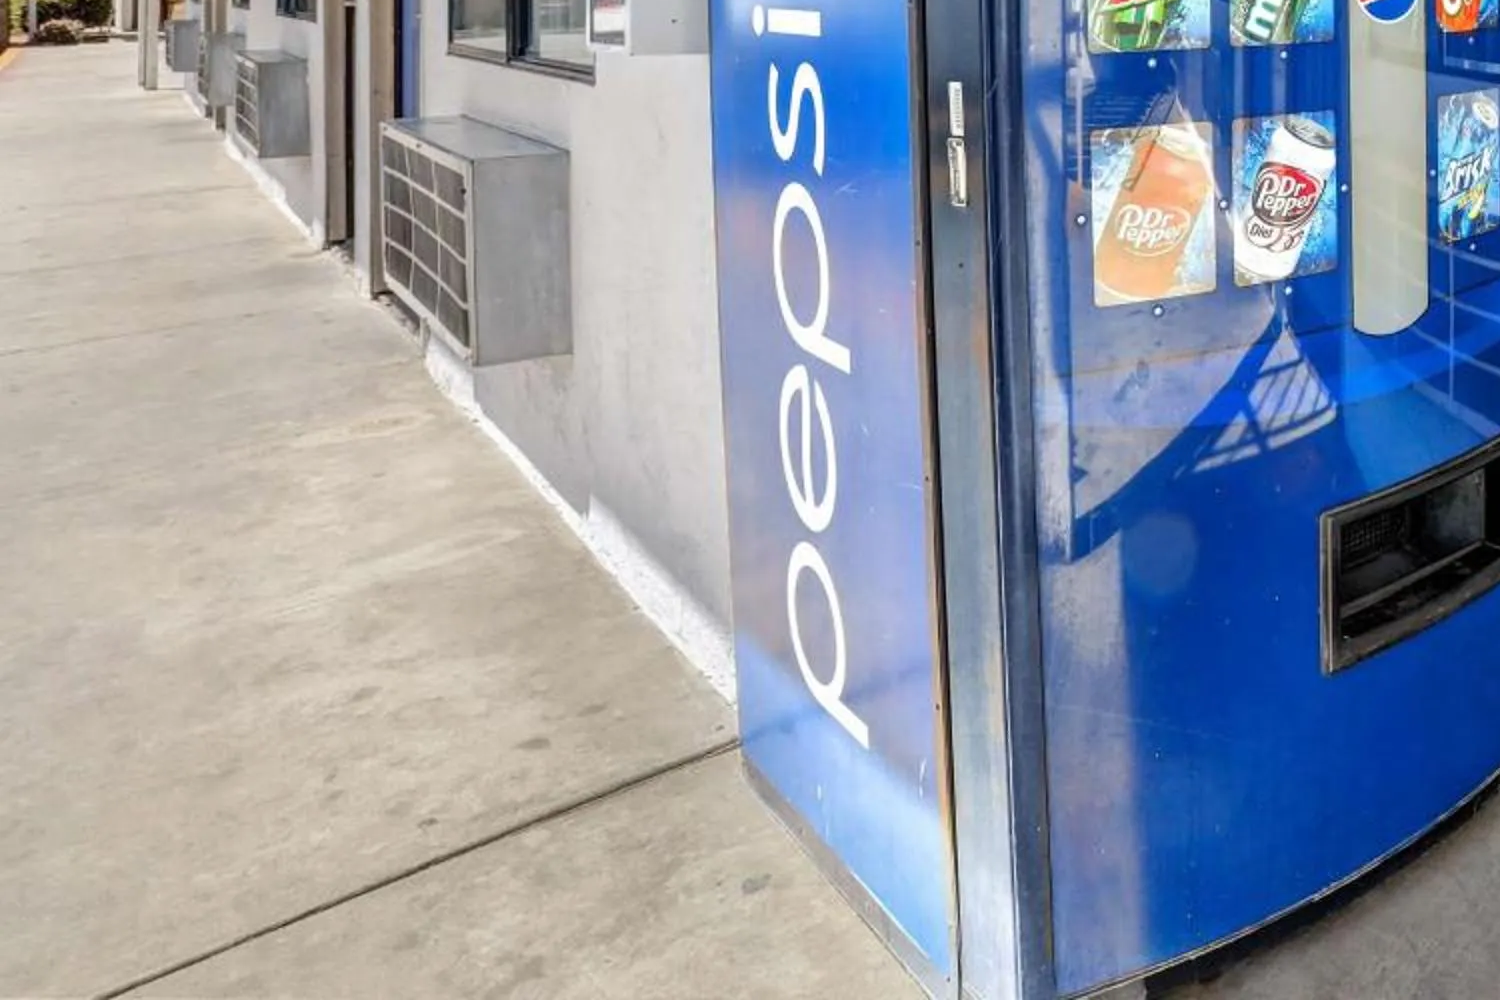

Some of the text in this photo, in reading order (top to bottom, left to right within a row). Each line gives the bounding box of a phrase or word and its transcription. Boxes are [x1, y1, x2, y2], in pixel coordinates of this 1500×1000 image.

[1255, 172, 1318, 217] Pepper
[1277, 174, 1307, 198] Dr
[1116, 204, 1184, 249] Pepper
[1142, 206, 1176, 229] Dr
[752, 3, 870, 749] pepsi
